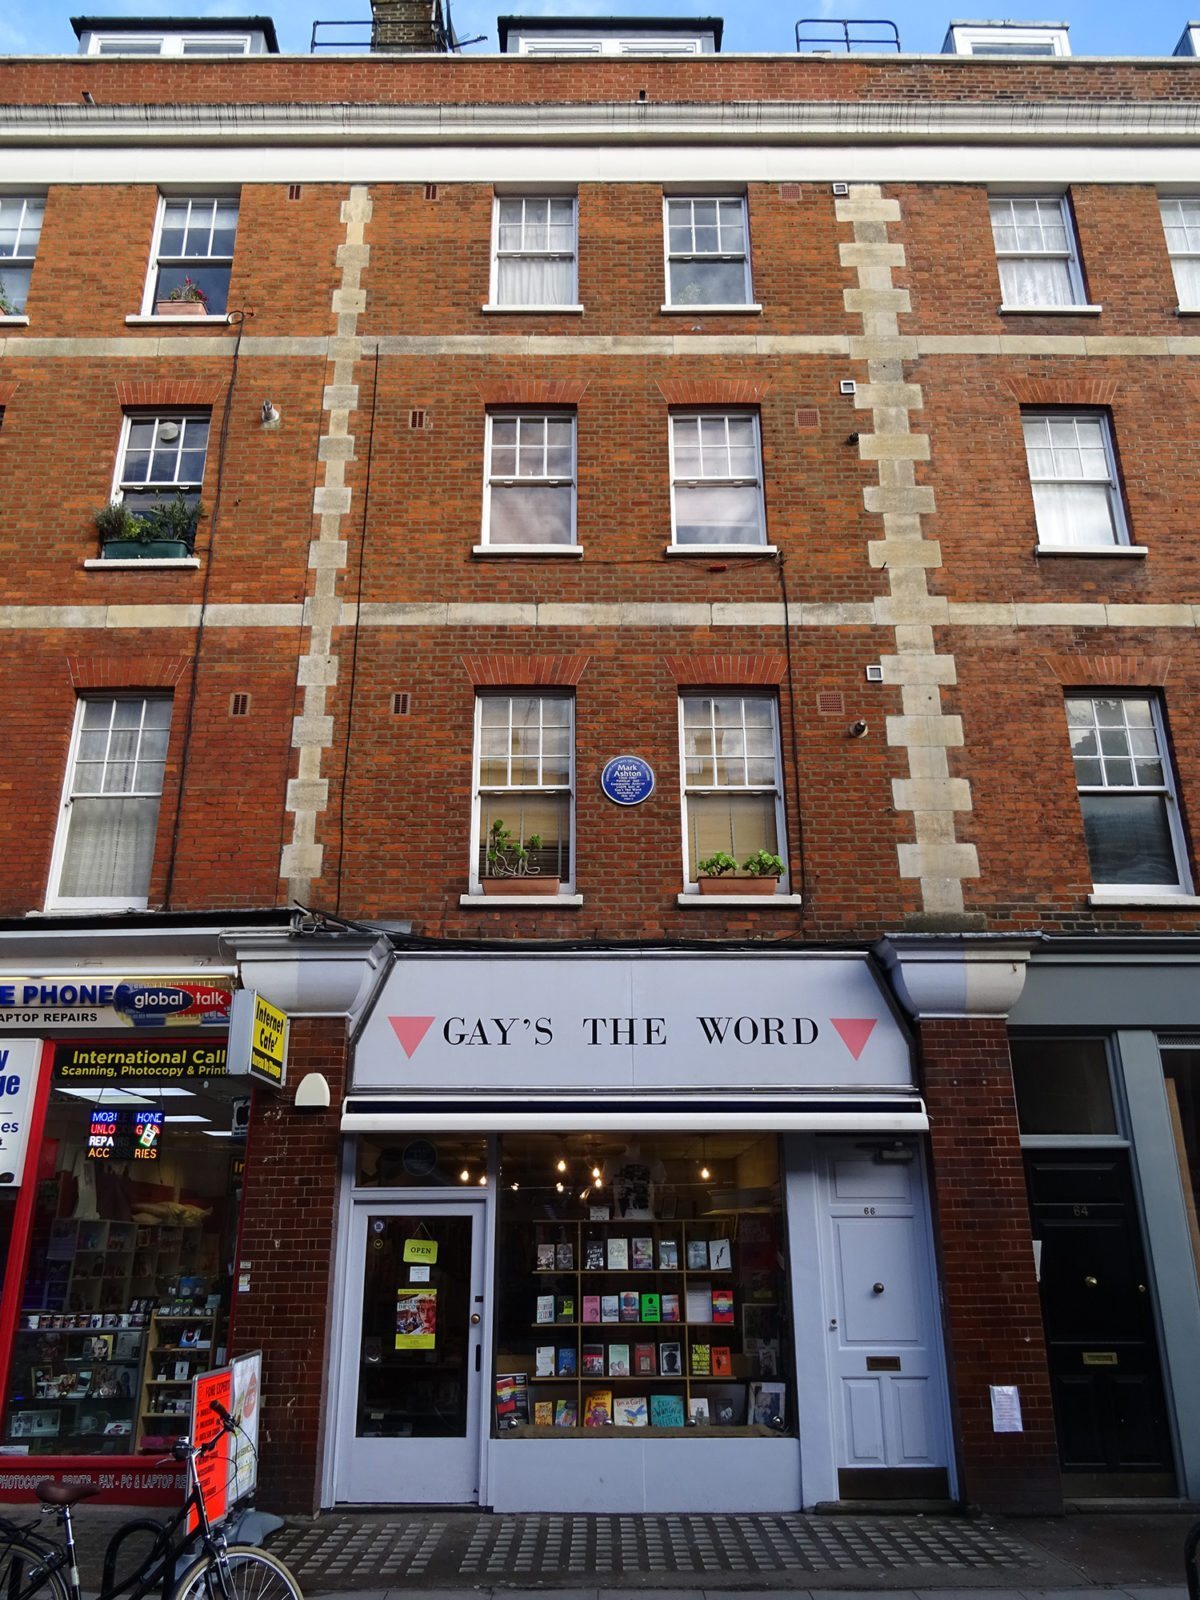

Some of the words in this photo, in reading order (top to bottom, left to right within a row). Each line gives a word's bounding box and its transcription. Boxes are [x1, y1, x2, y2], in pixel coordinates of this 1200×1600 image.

[134, 991, 183, 1008] global
[196, 991, 225, 1005] talk
[44, 1013, 97, 1022] REPAIRS
[255, 1001, 284, 1035] Internet
[443, 1017, 553, 1046] GAY'S
[583, 1017, 667, 1045] THE
[696, 1017, 819, 1046] WORD
[73, 1050, 186, 1064] International
[61, 1065, 118, 1077] Scanning,
[121, 1065, 184, 1077] Photocopy
[187, 1065, 195, 1075] &
[864, 1207, 876, 1215] 66
[1073, 1205, 1088, 1216] 64
[99, 1474, 115, 1489] FAX
[120, 1474, 133, 1489] PC
[141, 1474, 174, 1489] LAPTOP
